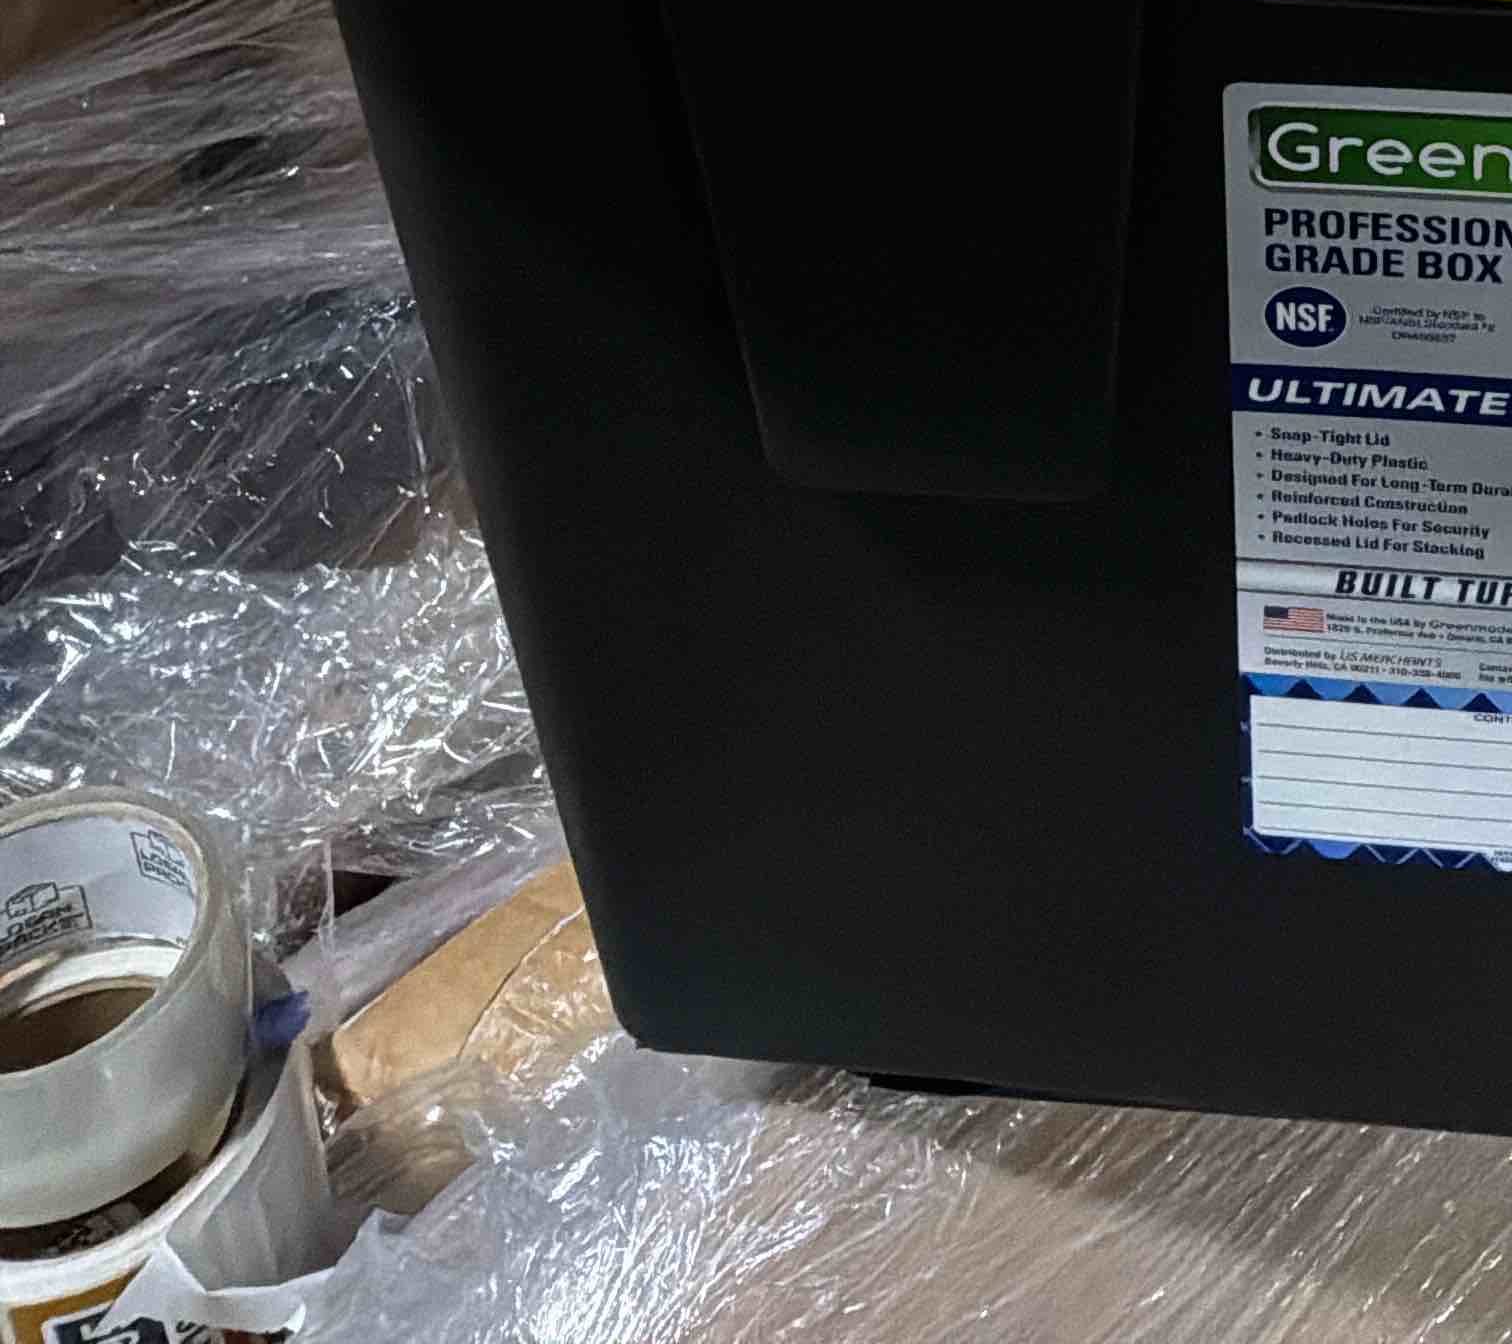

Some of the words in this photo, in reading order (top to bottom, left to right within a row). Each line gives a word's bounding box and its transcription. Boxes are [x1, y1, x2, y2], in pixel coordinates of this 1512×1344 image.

[1265, 243, 1404, 279] GRADE
[1418, 252, 1503, 284] BOX
[1276, 301, 1335, 333] NSF
[1248, 377, 1512, 416] ULTIMATE
[1271, 427, 1361, 446] Snap-Tight
[1365, 432, 1391, 446] Lid
[1271, 449, 1367, 469] Heavy-Duty
[1371, 454, 1428, 470] Plastic
[1271, 469, 1348, 487] Designed
[1351, 474, 1377, 488] For
[1381, 477, 1467, 494] Long-Term
[1272, 490, 1360, 508] Reinforced
[1364, 495, 1468, 515] Construction
[1272, 510, 1338, 527] Padlock
[1342, 514, 1388, 530] Holes
[1392, 517, 1417, 533] For
[1422, 520, 1490, 540] Security
[1272, 530, 1351, 549] Recessed
[1356, 535, 1380, 551] Lid
[1383, 538, 1409, 553] For
[1413, 541, 1486, 560] Stacking
[1335, 570, 1440, 600] BUILT
